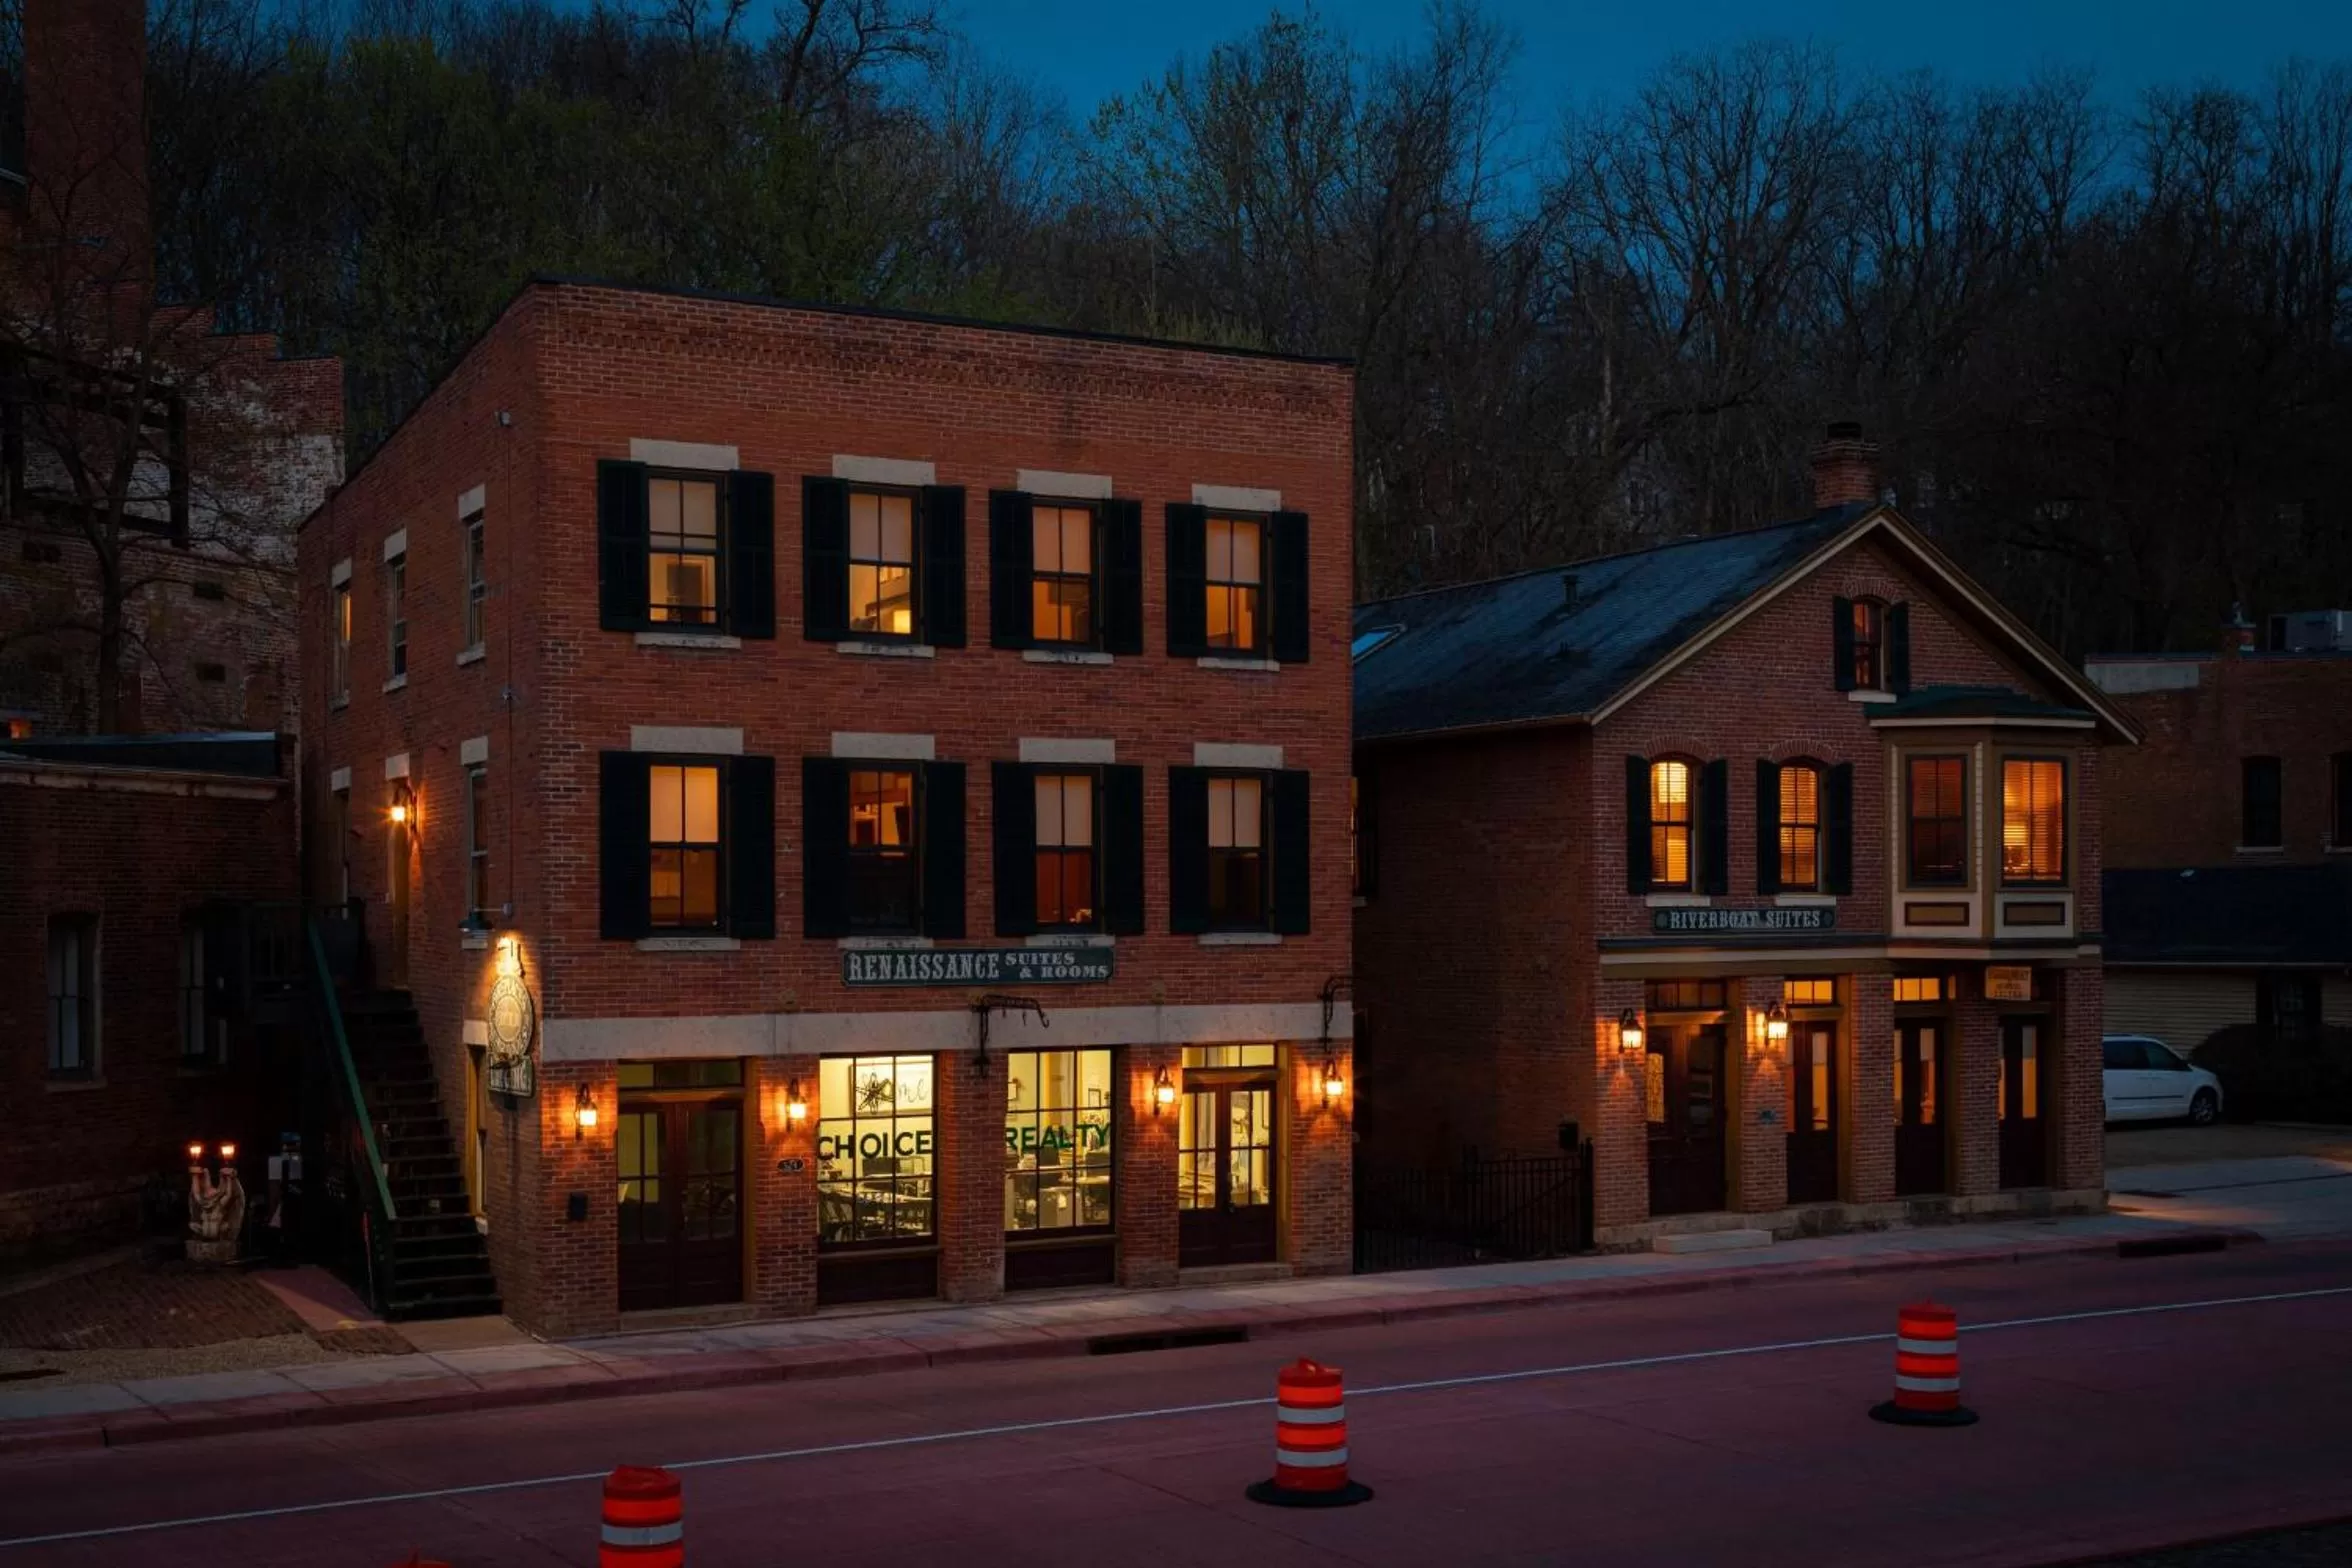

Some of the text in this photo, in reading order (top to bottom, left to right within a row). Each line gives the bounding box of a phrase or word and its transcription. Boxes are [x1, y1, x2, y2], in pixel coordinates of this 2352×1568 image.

[1670, 910, 1821, 929] RIVERBOAT SUITES
[847, 951, 1076, 981] RENAISSANCE SUITES
[1019, 964, 1110, 980] & ROOMS
[818, 1130, 933, 1161] CHOICE
[1005, 1122, 1111, 1151] REALTY
